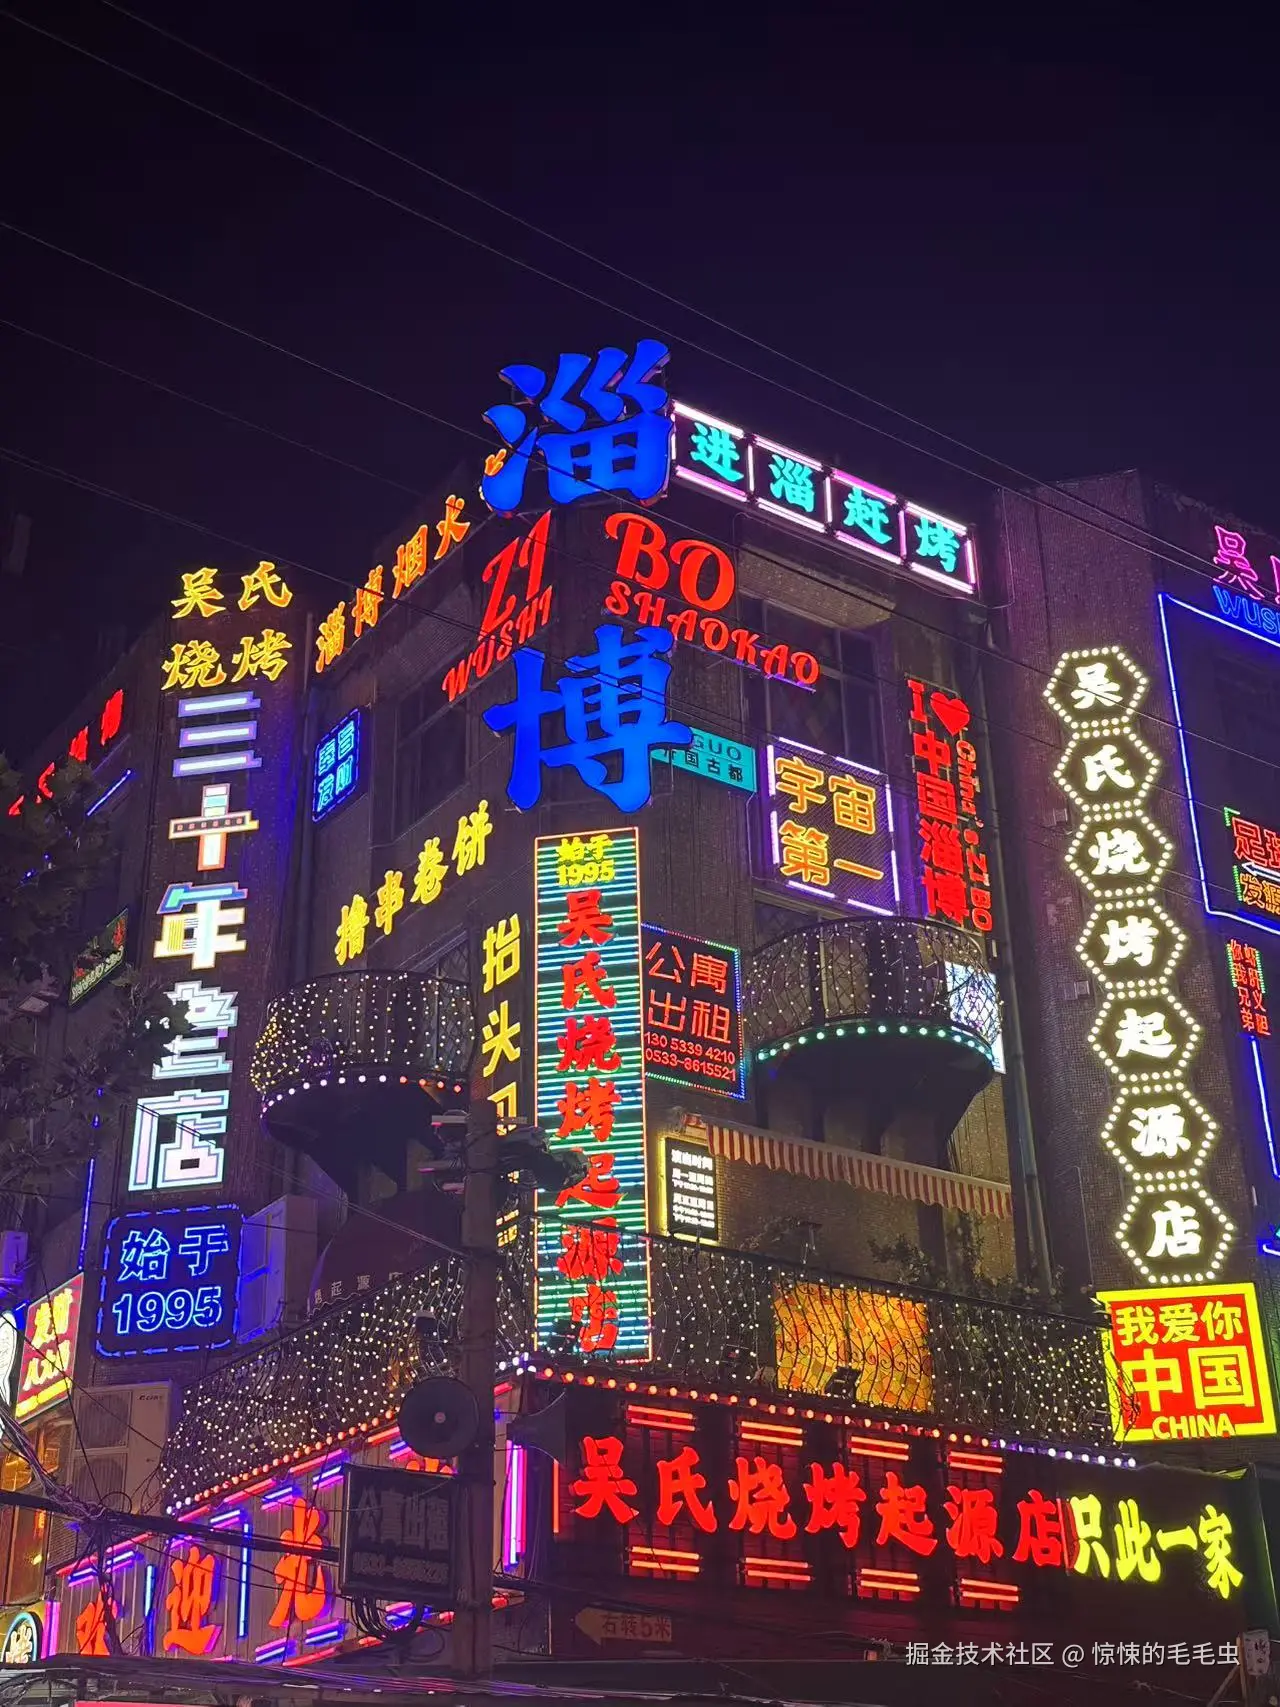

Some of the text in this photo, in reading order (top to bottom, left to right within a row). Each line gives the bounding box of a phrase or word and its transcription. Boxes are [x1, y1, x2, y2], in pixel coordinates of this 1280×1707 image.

[481, 338, 674, 513] 淄
[690, 421, 960, 573] 进淄赶烤
[171, 561, 293, 619] 吴氏
[604, 512, 736, 612] BO
[442, 581, 820, 702] WUSHI SHAOKAO
[1213, 584, 1280, 637] WUS
[161, 628, 293, 691] 烧烤
[482, 623, 694, 814] 博
[775, 756, 877, 836] 宇宙
[555, 834, 614, 862] 始于
[779, 820, 885, 888] 第一
[911, 729, 970, 927] 中国淄博
[557, 860, 616, 887] 1995
[646, 940, 729, 995] 公寓
[1070, 662, 1202, 1258] 吴氏烧烤起源店
[644, 1032, 736, 1065] 130 5339 4210
[647, 988, 732, 1046] 出租
[645, 1049, 737, 1082] 0533-8615521
[119, 1224, 229, 1281] 始于
[112, 1286, 223, 1335] 1995
[1116, 1300, 1243, 1346] 我爱你
[1121, 1346, 1256, 1412] 中国
[1151, 1412, 1236, 1441] CHINA
[569, 1436, 1066, 1568] 吴氏烧烤起源店
[1070, 1494, 1244, 1600] 只此一家
